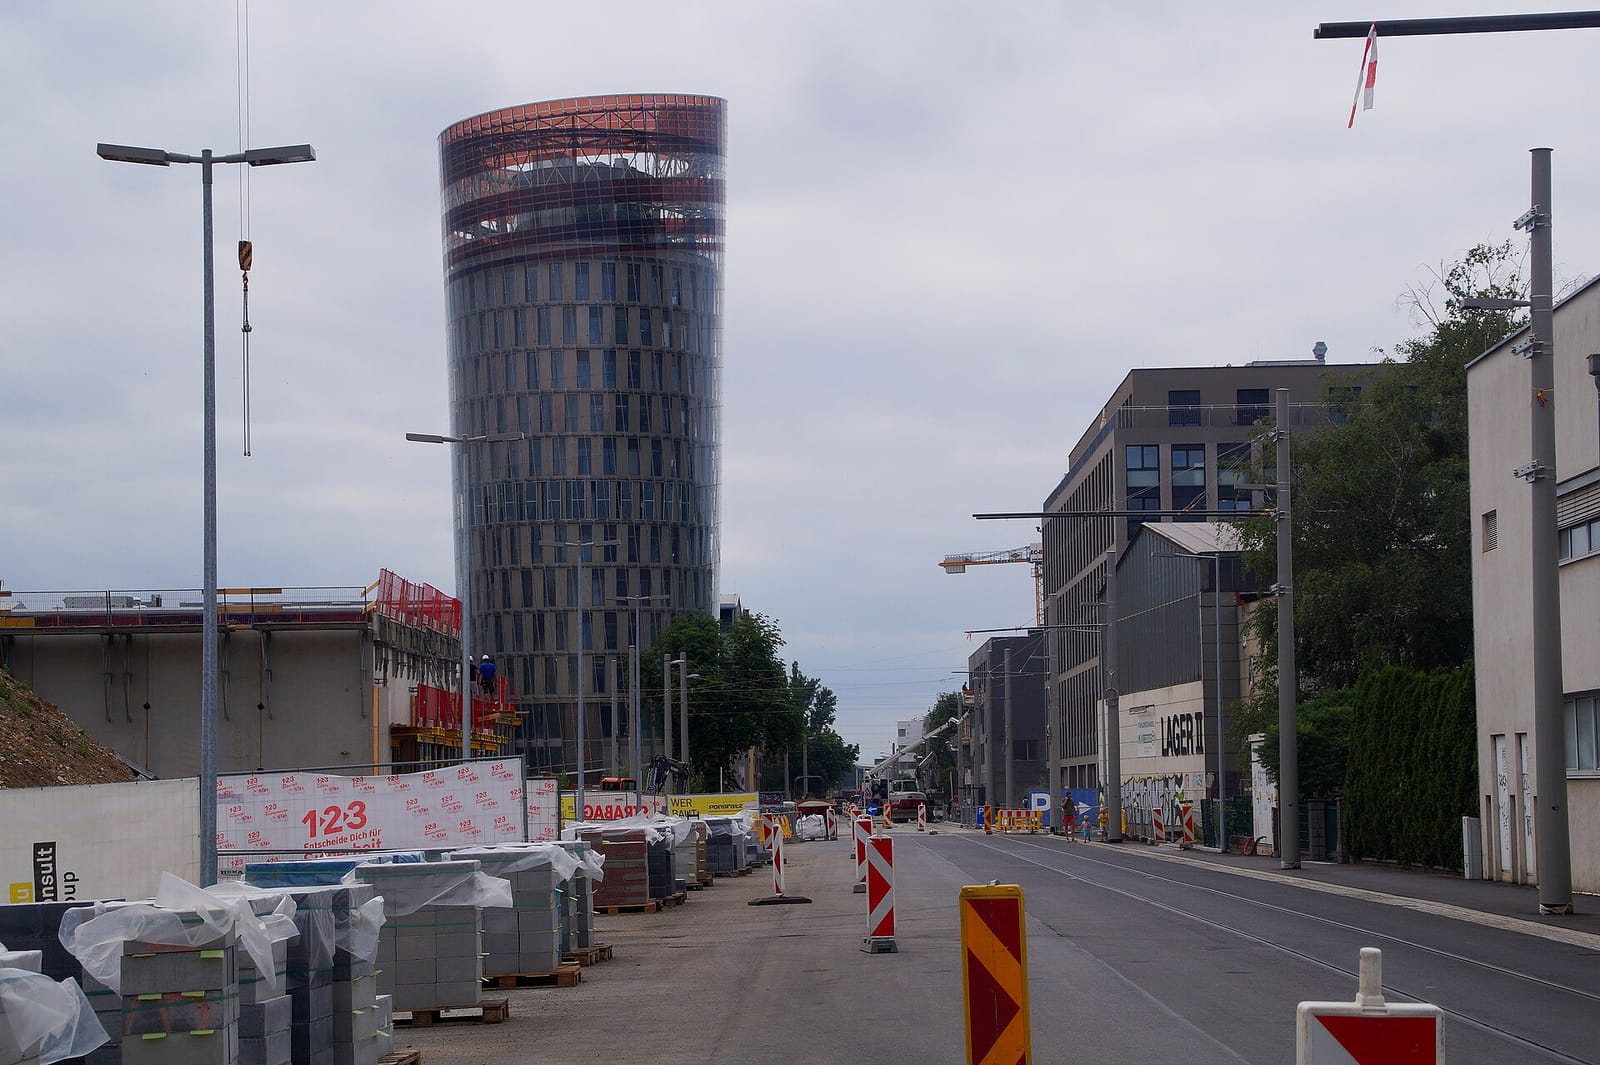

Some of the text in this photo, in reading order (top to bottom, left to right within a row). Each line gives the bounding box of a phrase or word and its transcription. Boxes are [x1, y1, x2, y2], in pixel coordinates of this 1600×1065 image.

[1161, 711, 1204, 758] LAGER II
[670, 798, 693, 808] WER
[1031, 793, 1051, 812] P
[304, 836, 348, 849] Entscheide
[350, 832, 367, 842] Dich
[370, 828, 382, 838] für
